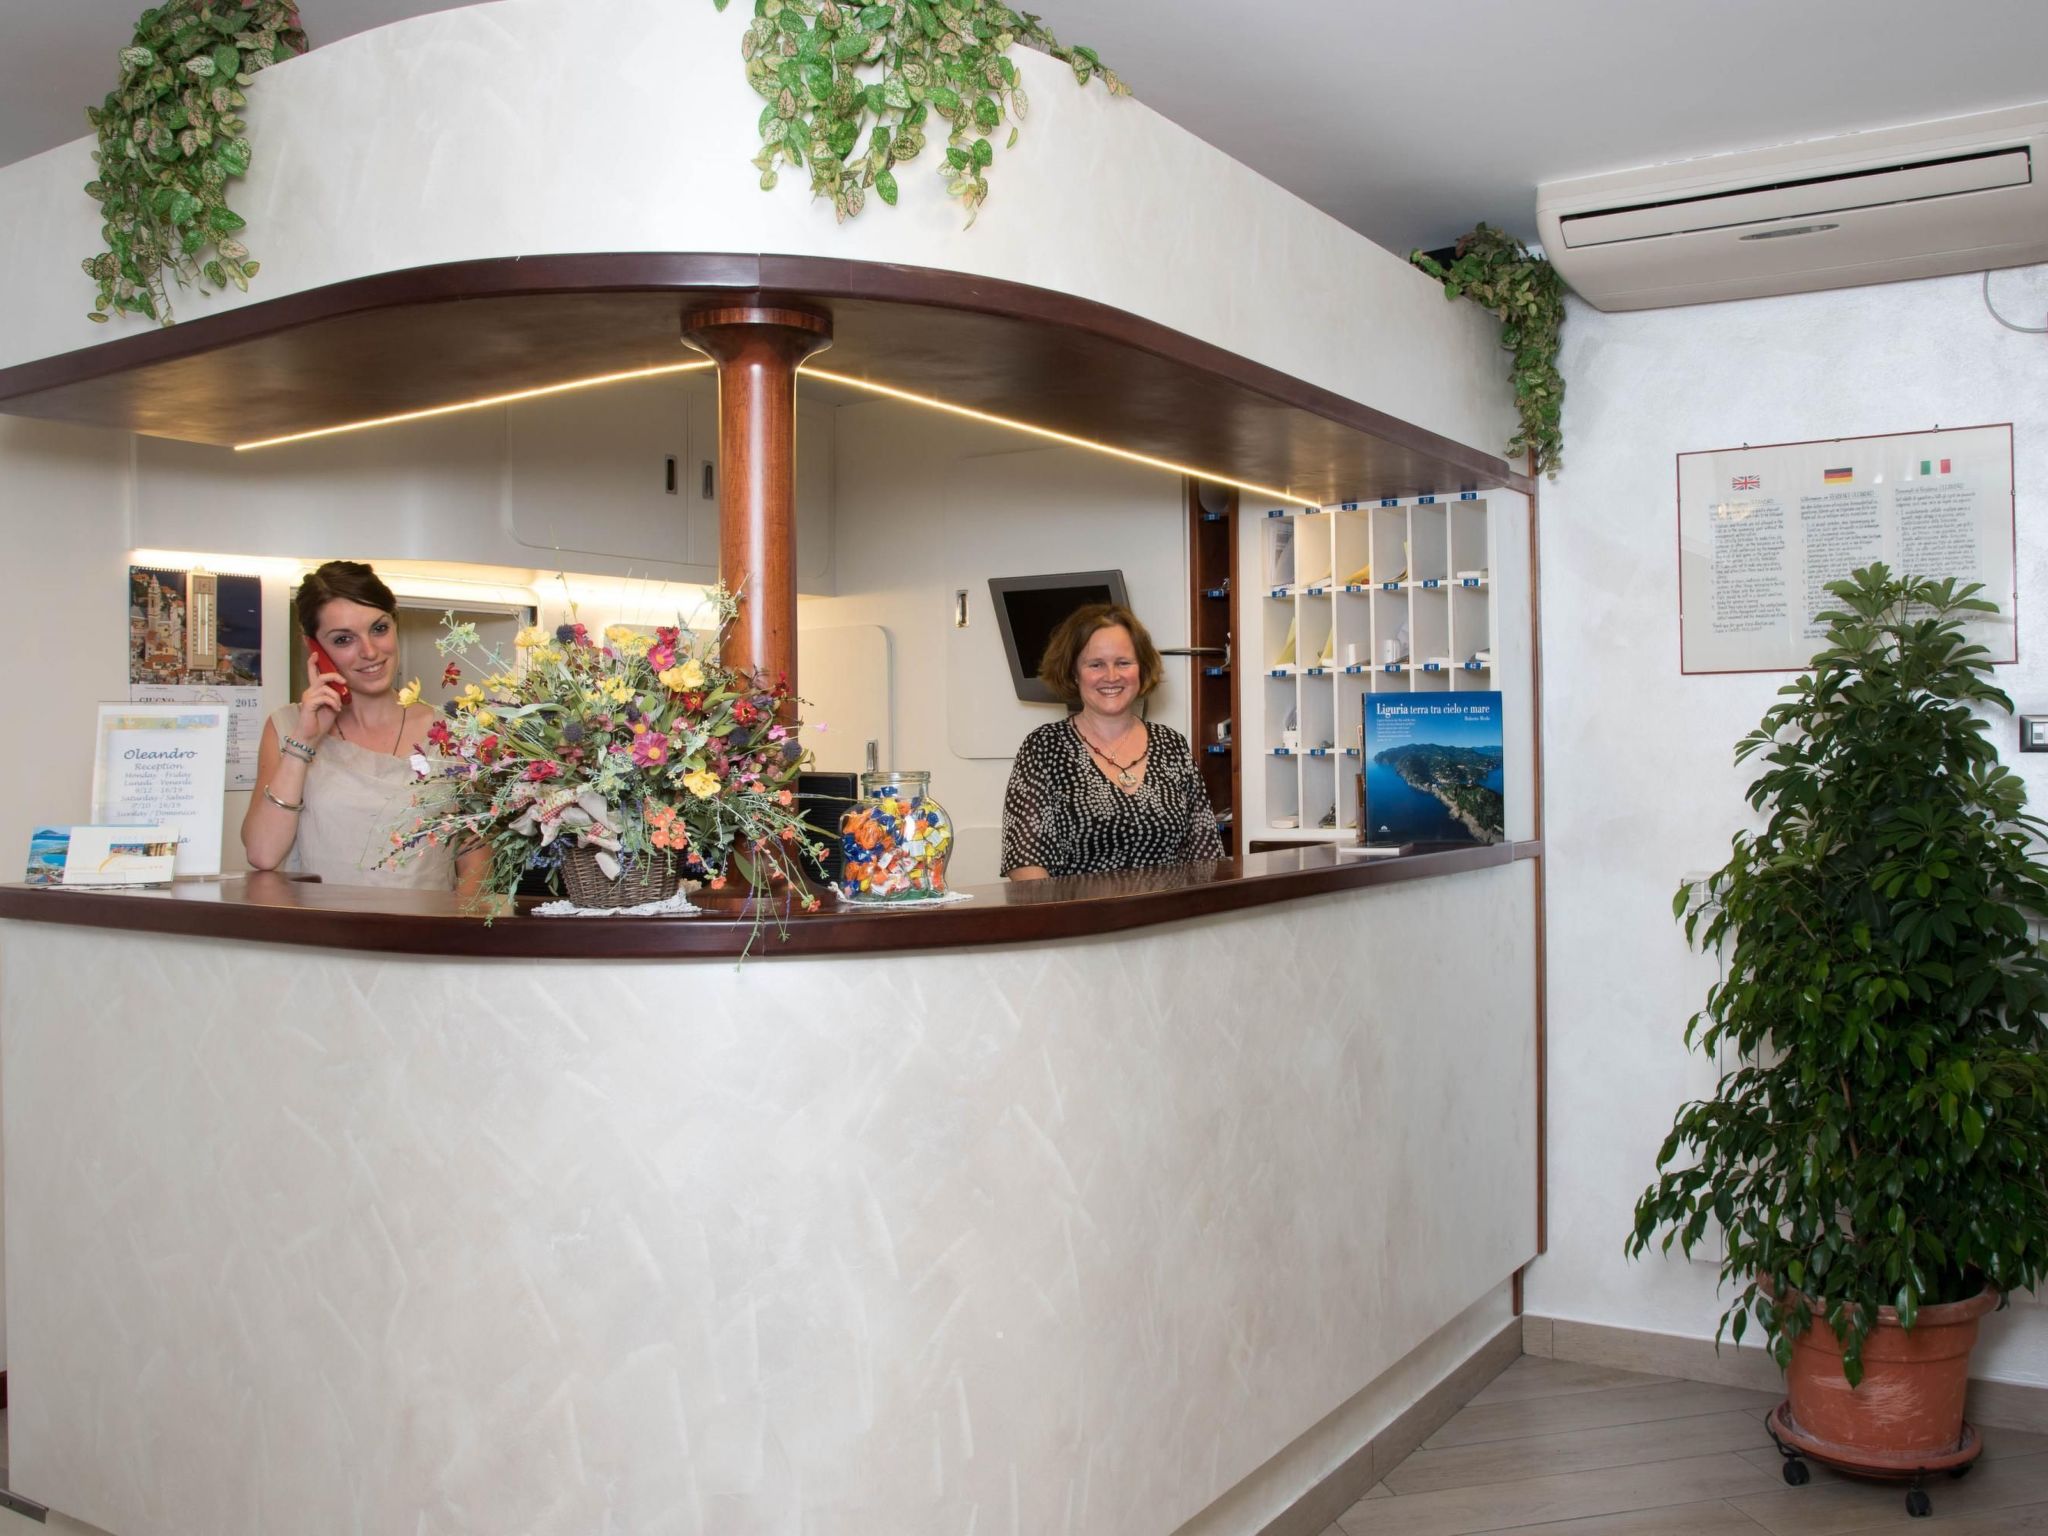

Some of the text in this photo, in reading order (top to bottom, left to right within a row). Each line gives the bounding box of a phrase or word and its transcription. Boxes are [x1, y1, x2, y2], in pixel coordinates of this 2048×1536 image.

[235, 699, 257, 708] 2015
[1377, 703, 1408, 718] Liguria
[1410, 705, 1428, 715] terra
[1430, 705, 1441, 714] tra
[1443, 703, 1461, 714] cielo
[1470, 705, 1490, 714] mare
[124, 748, 198, 760] Oleandro
[135, 762, 183, 772] Reception
